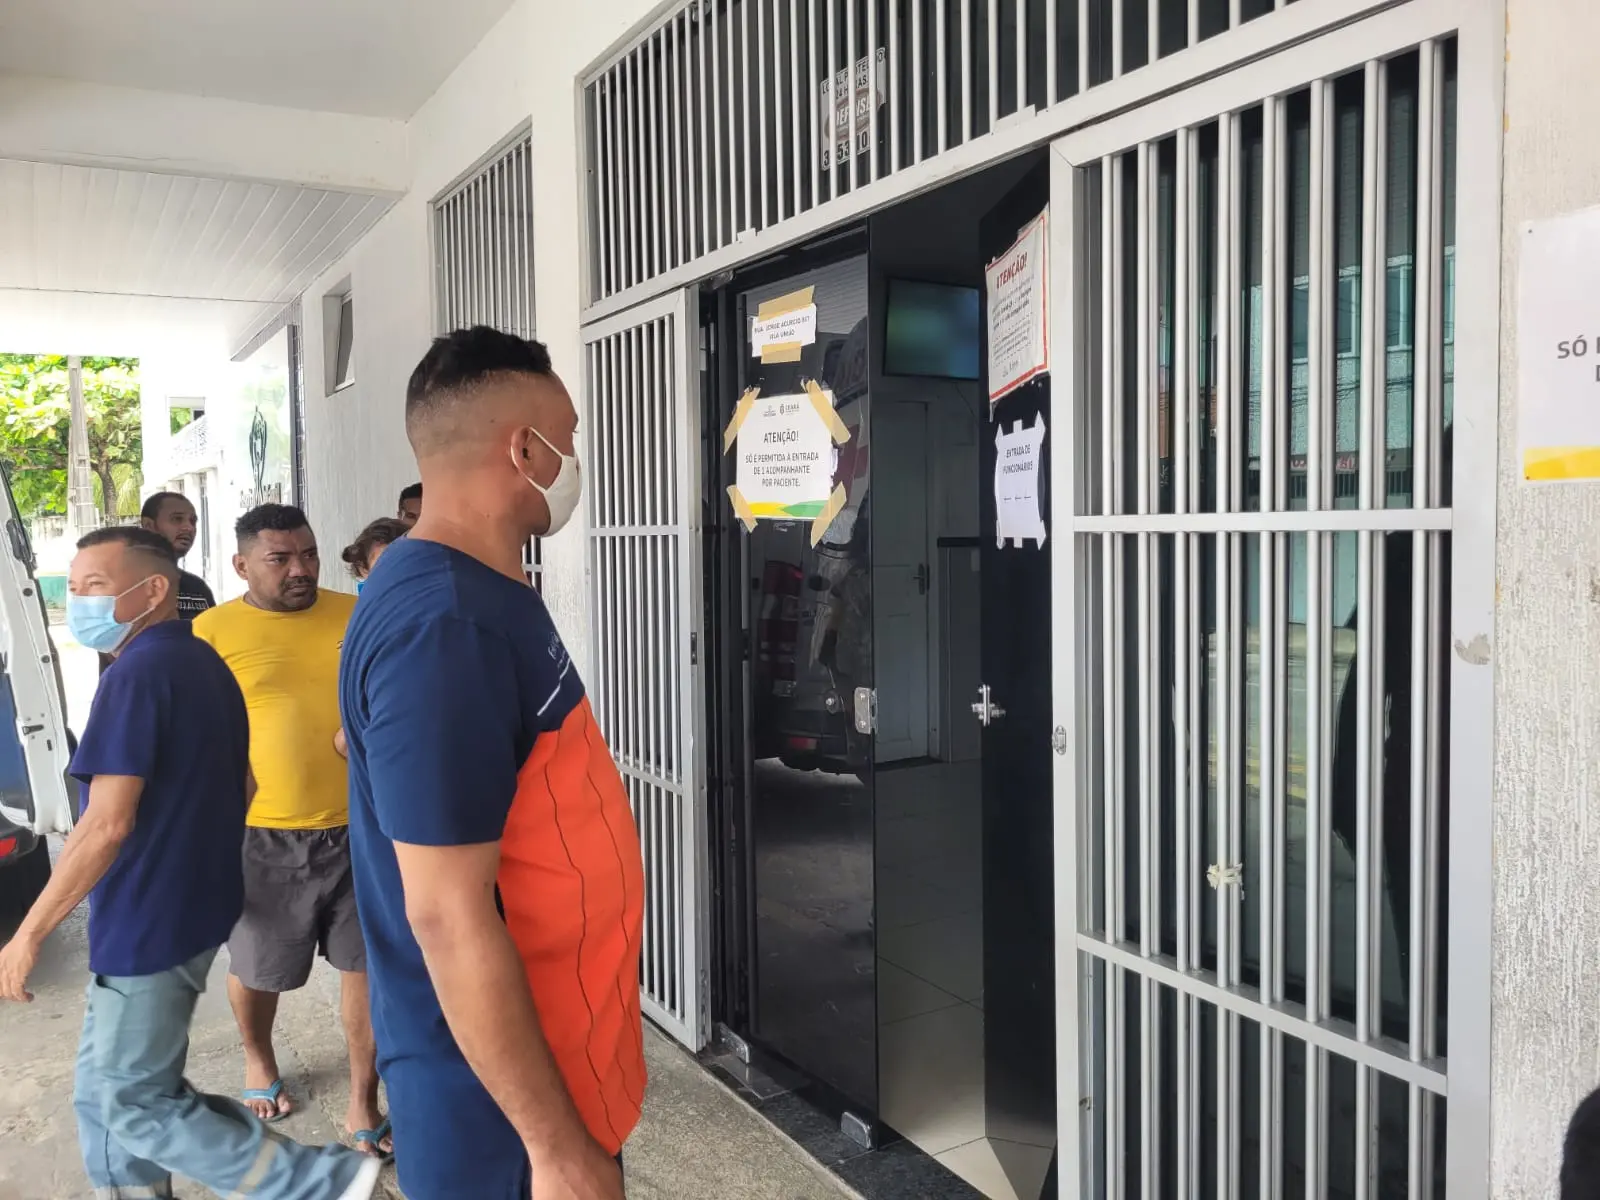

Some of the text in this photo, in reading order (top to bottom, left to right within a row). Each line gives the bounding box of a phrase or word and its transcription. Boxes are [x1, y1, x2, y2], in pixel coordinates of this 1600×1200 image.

[1557, 334, 1588, 360] SÓ
[763, 428, 799, 445] ATENÇÃO!
[745, 453, 753, 463] SÓ
[753, 452, 758, 463] É
[758, 452, 786, 463] PERMITIDA
[792, 451, 819, 461] ENTRADA
[1006, 444, 1031, 458] ENTRADA DE
[753, 464, 810, 475] DE 1 ACOMPANHANTE
[1002, 460, 1033, 475] FUNCIONÁRIOS
[762, 477, 801, 487] POR PACIENTE.
